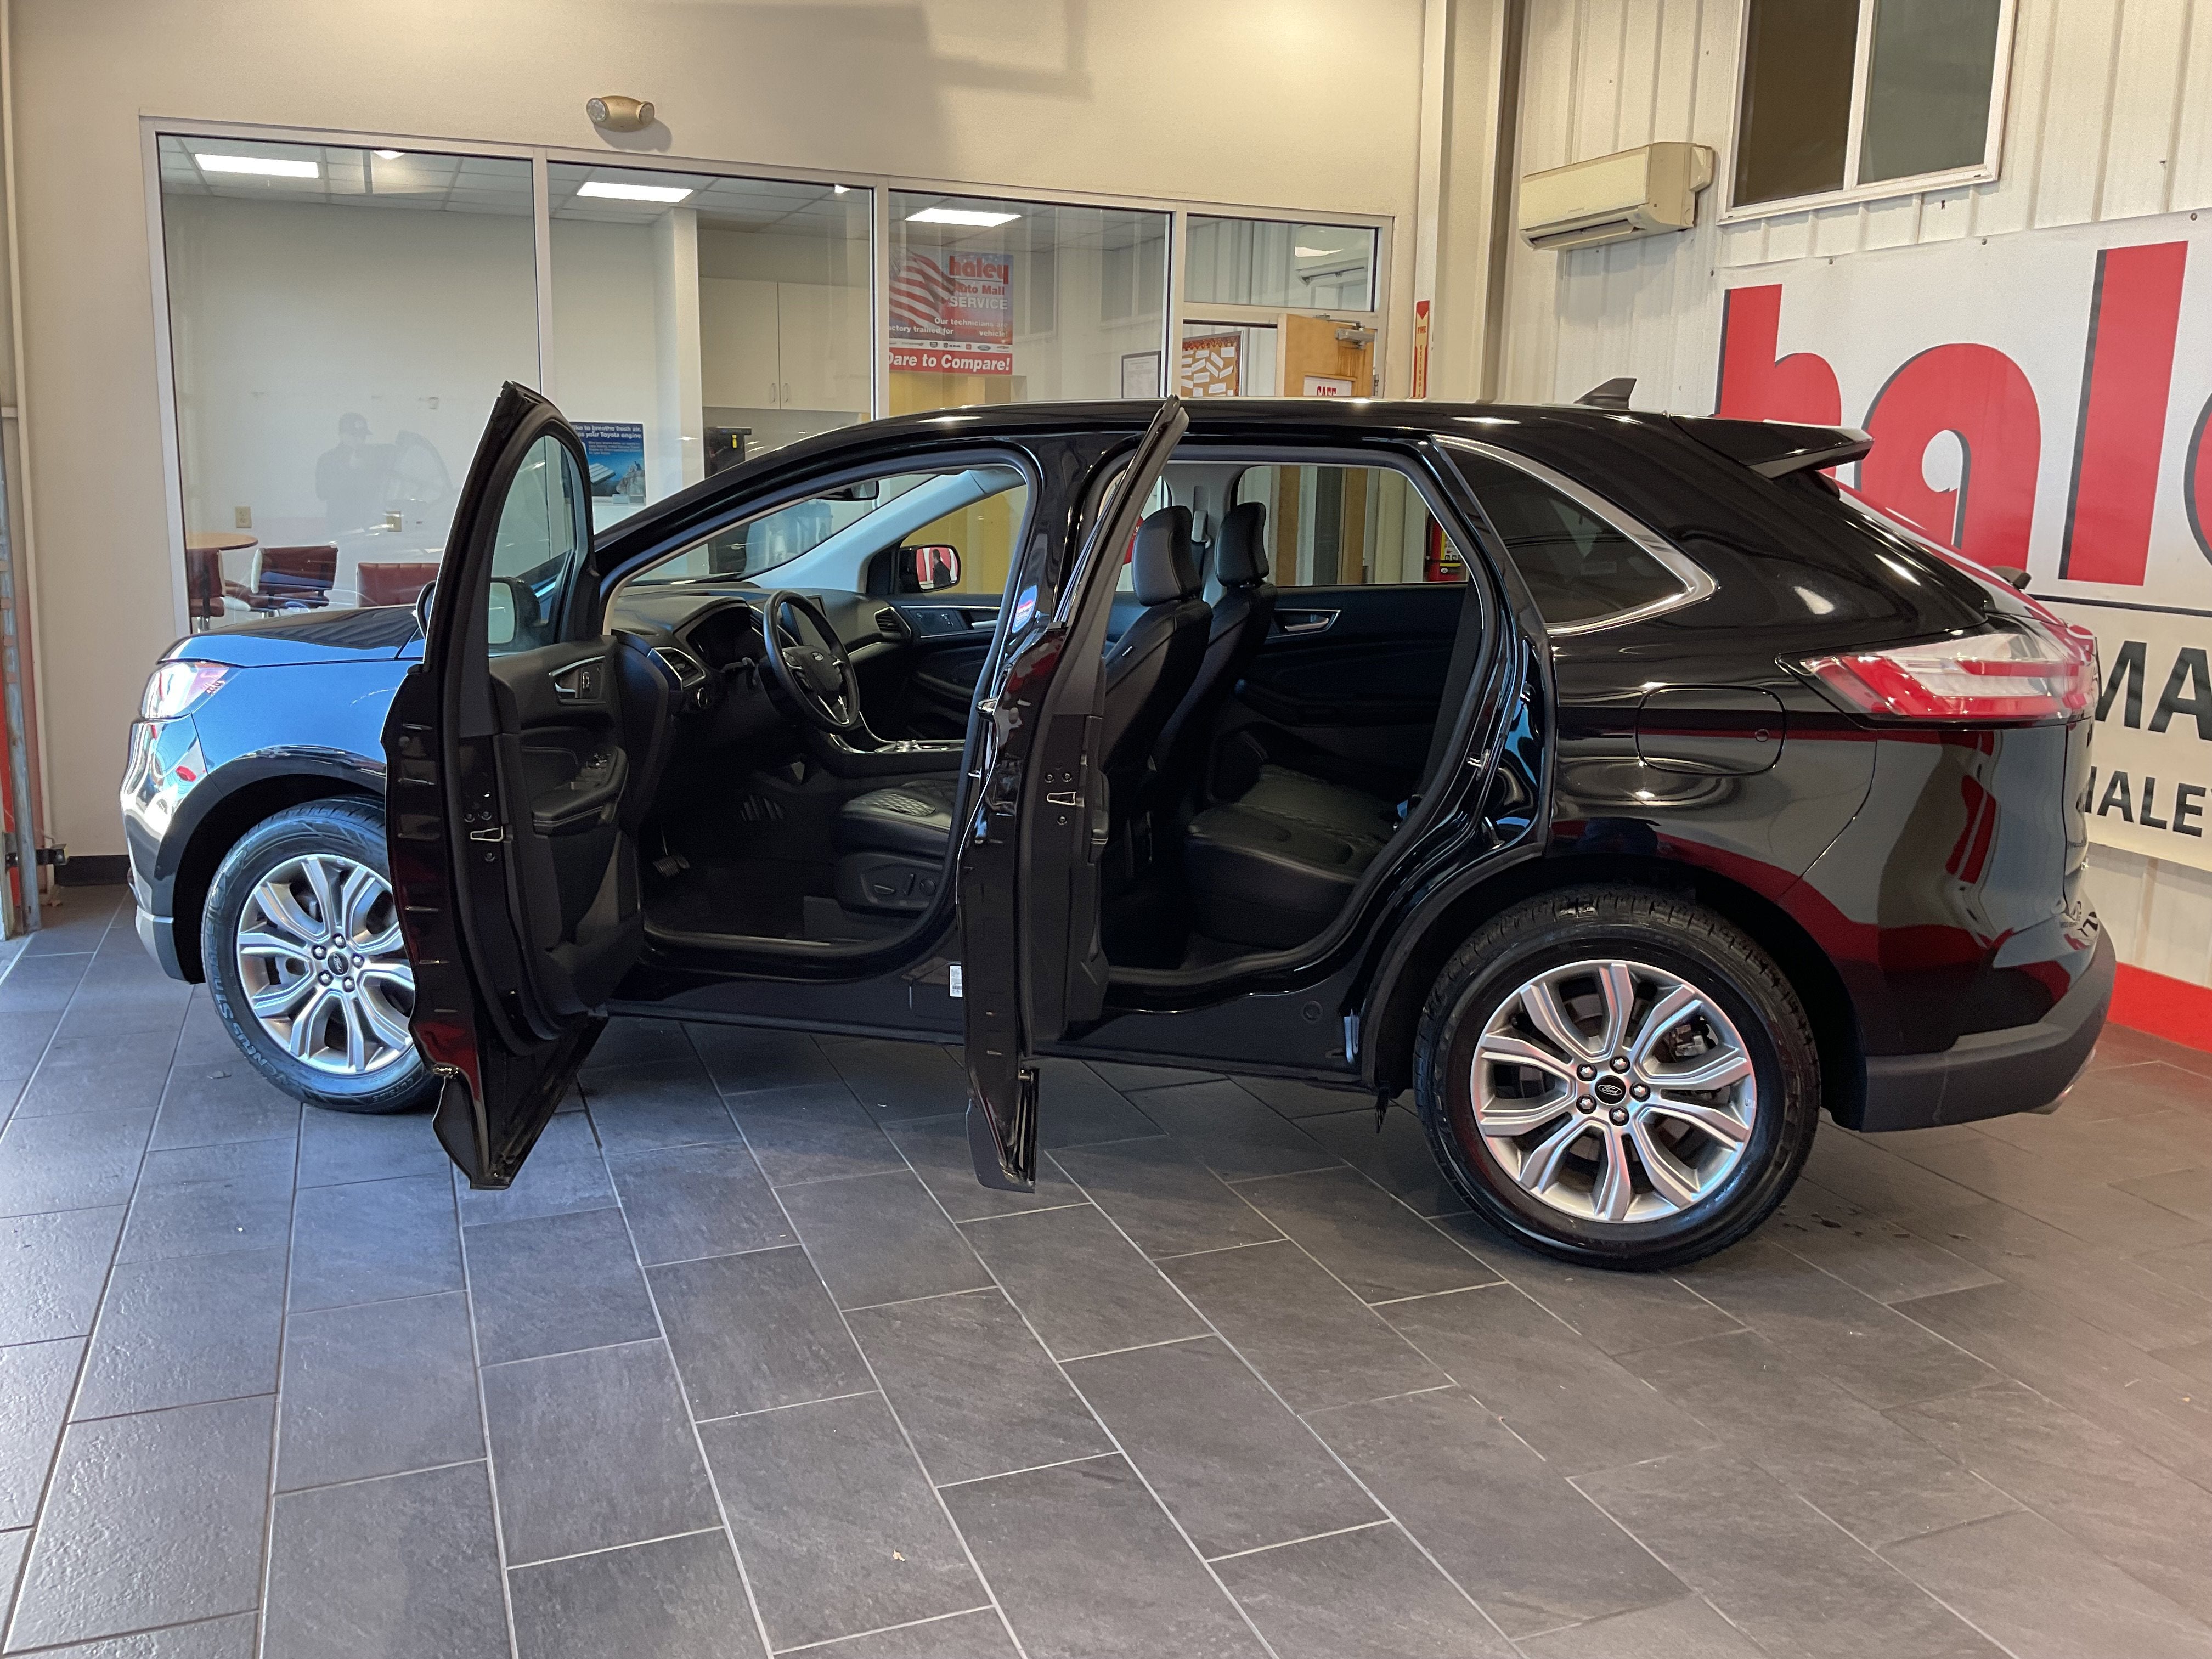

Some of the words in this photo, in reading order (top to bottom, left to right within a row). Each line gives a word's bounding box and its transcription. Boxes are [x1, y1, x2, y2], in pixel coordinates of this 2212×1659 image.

[949, 255, 1009, 284] haley
[955, 283, 978, 294] Auto
[981, 285, 1005, 295] Mall
[949, 296, 1007, 310] SERVICE
[951, 319, 994, 328] technicians
[913, 325, 940, 334] trained
[979, 329, 1008, 337] vehicle!
[1417, 326, 1427, 334] FIRE
[889, 351, 917, 366] Dare
[922, 354, 937, 367] to
[941, 354, 1011, 373] Compare!
[1601, 1085, 1619, 1095] Ford
